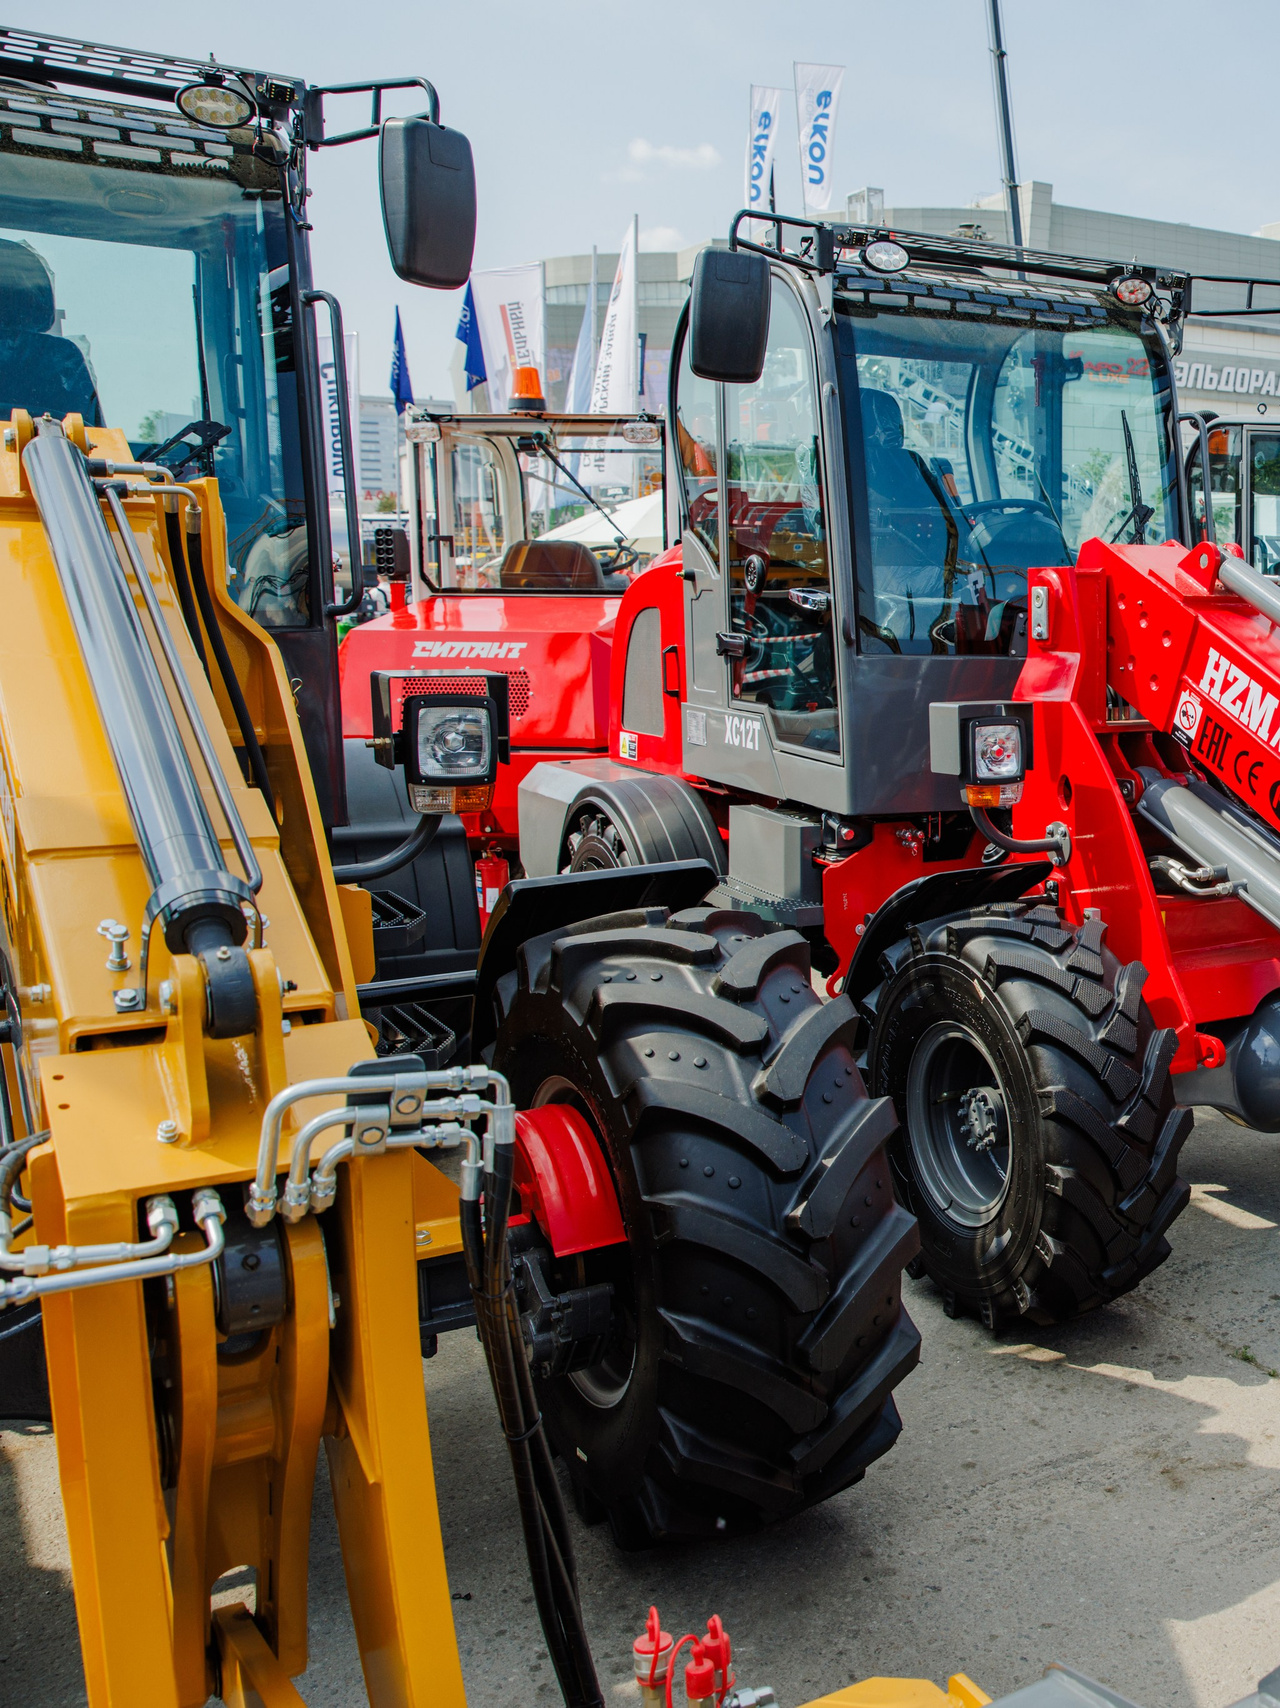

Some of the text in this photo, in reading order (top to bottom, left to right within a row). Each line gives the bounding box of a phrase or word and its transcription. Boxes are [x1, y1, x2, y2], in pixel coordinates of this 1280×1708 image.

[411, 641, 528, 659] СИЛАНТ
[1199, 646, 1279, 742] HZM
[724, 715, 761, 751] XC12T
